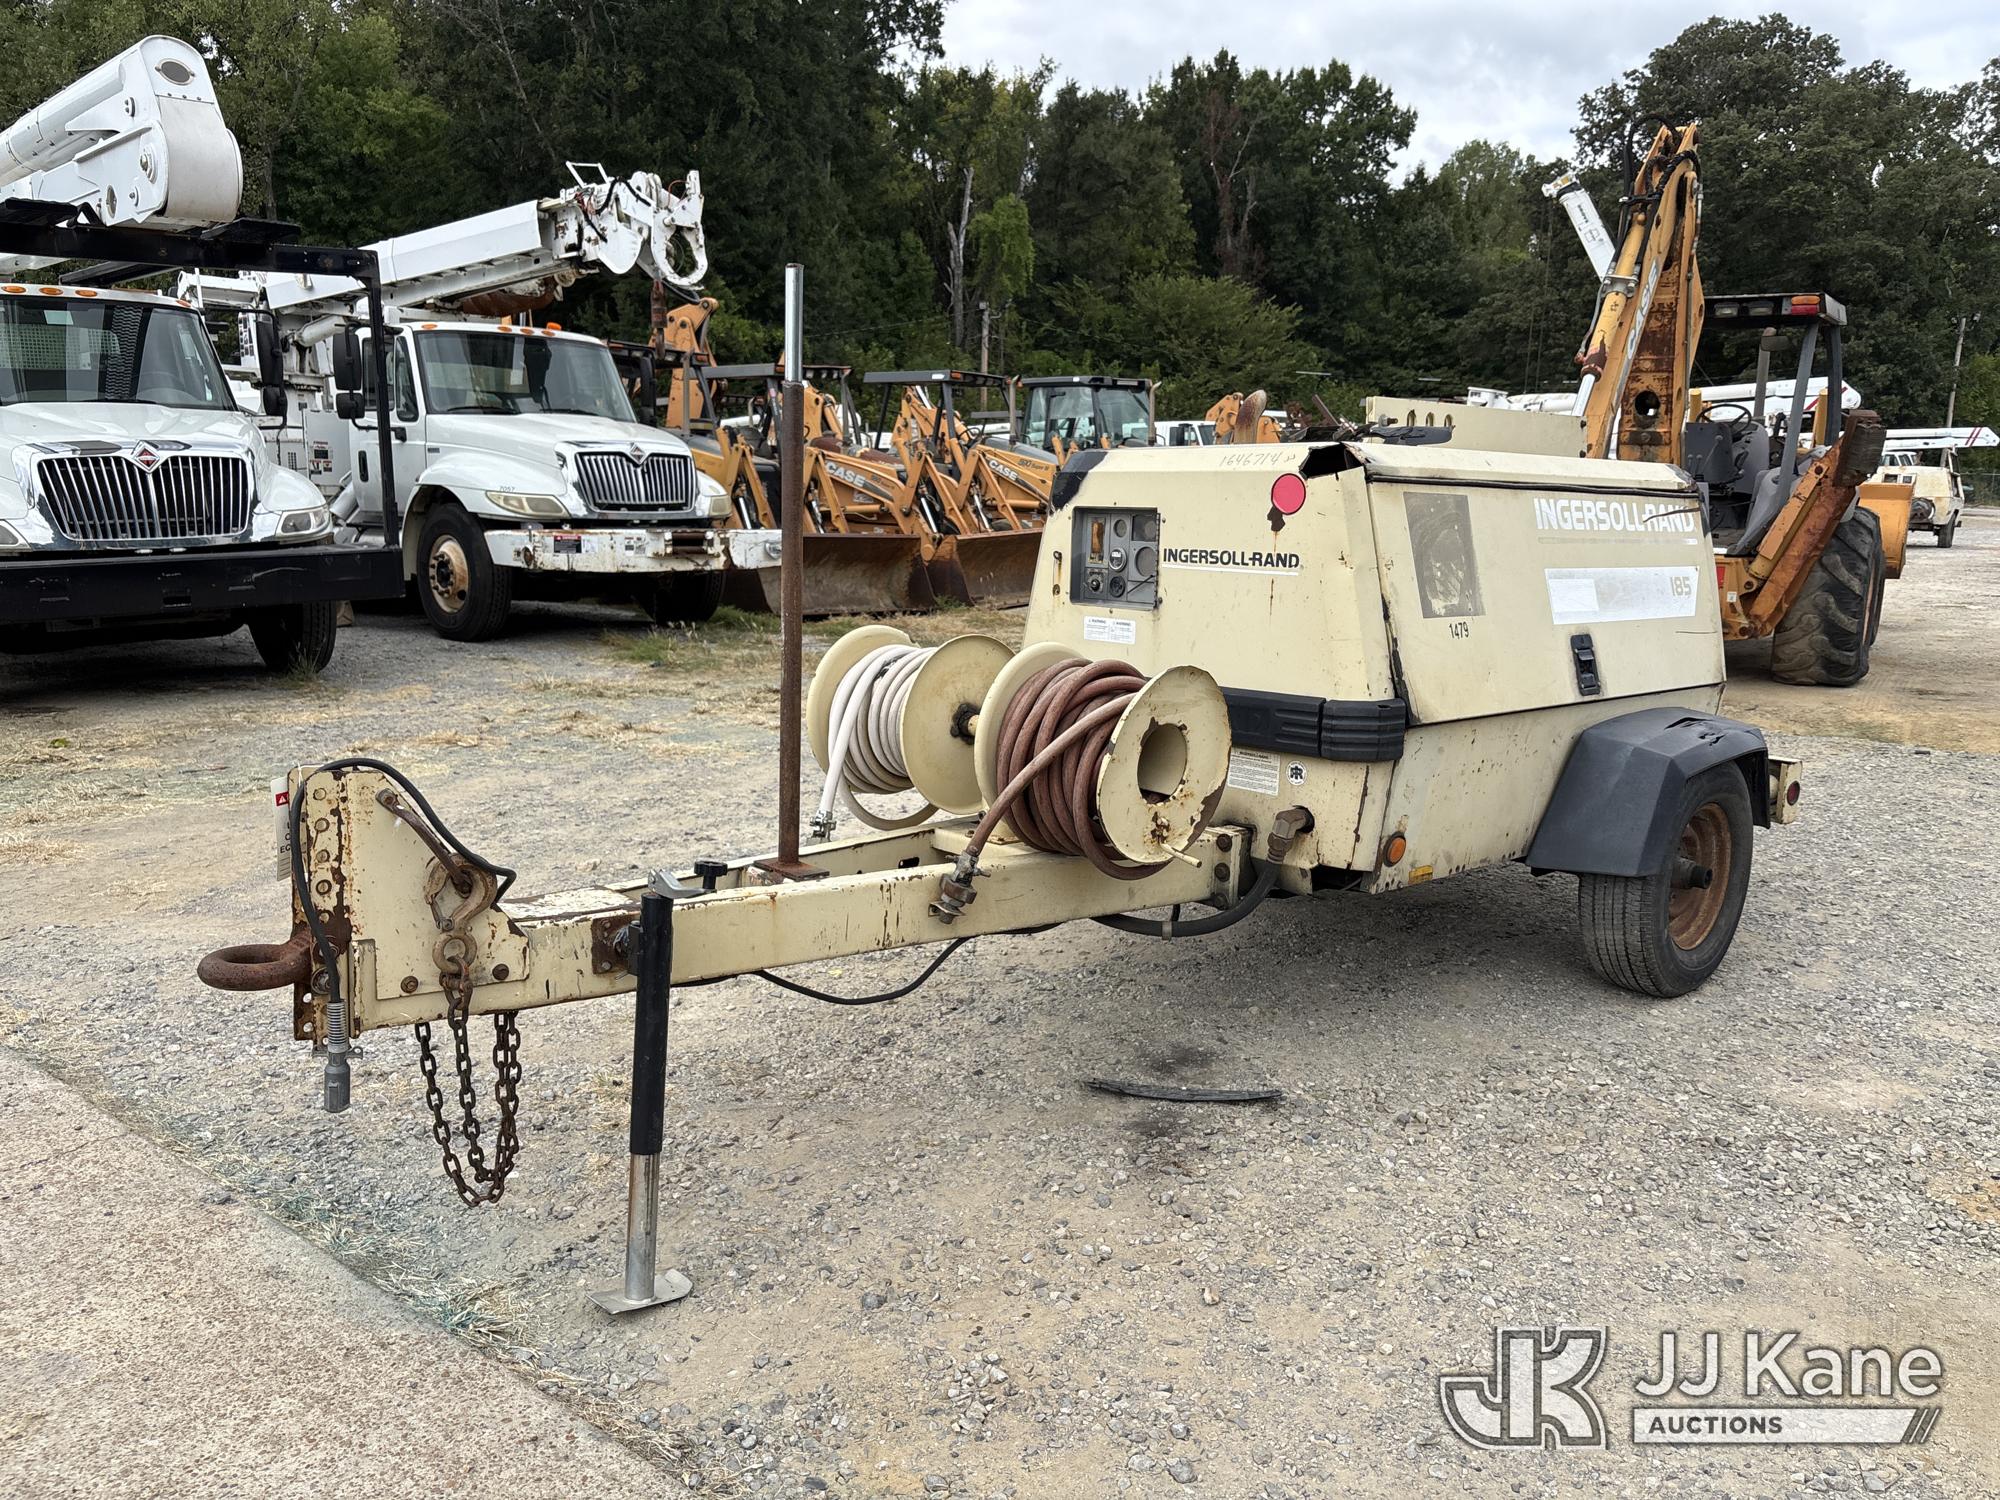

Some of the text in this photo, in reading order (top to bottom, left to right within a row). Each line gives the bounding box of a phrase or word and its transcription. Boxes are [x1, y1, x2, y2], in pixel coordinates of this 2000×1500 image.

[988, 459, 1018, 481] CASE
[1219, 453, 1283, 467] 1646714
[825, 462, 866, 488] CASE
[1533, 498, 1696, 533] INGERSOLL-RAND
[1163, 548, 1300, 568] INGERSOLL-RAND
[1670, 576, 1692, 597] 185
[1448, 621, 1469, 639] 1479
